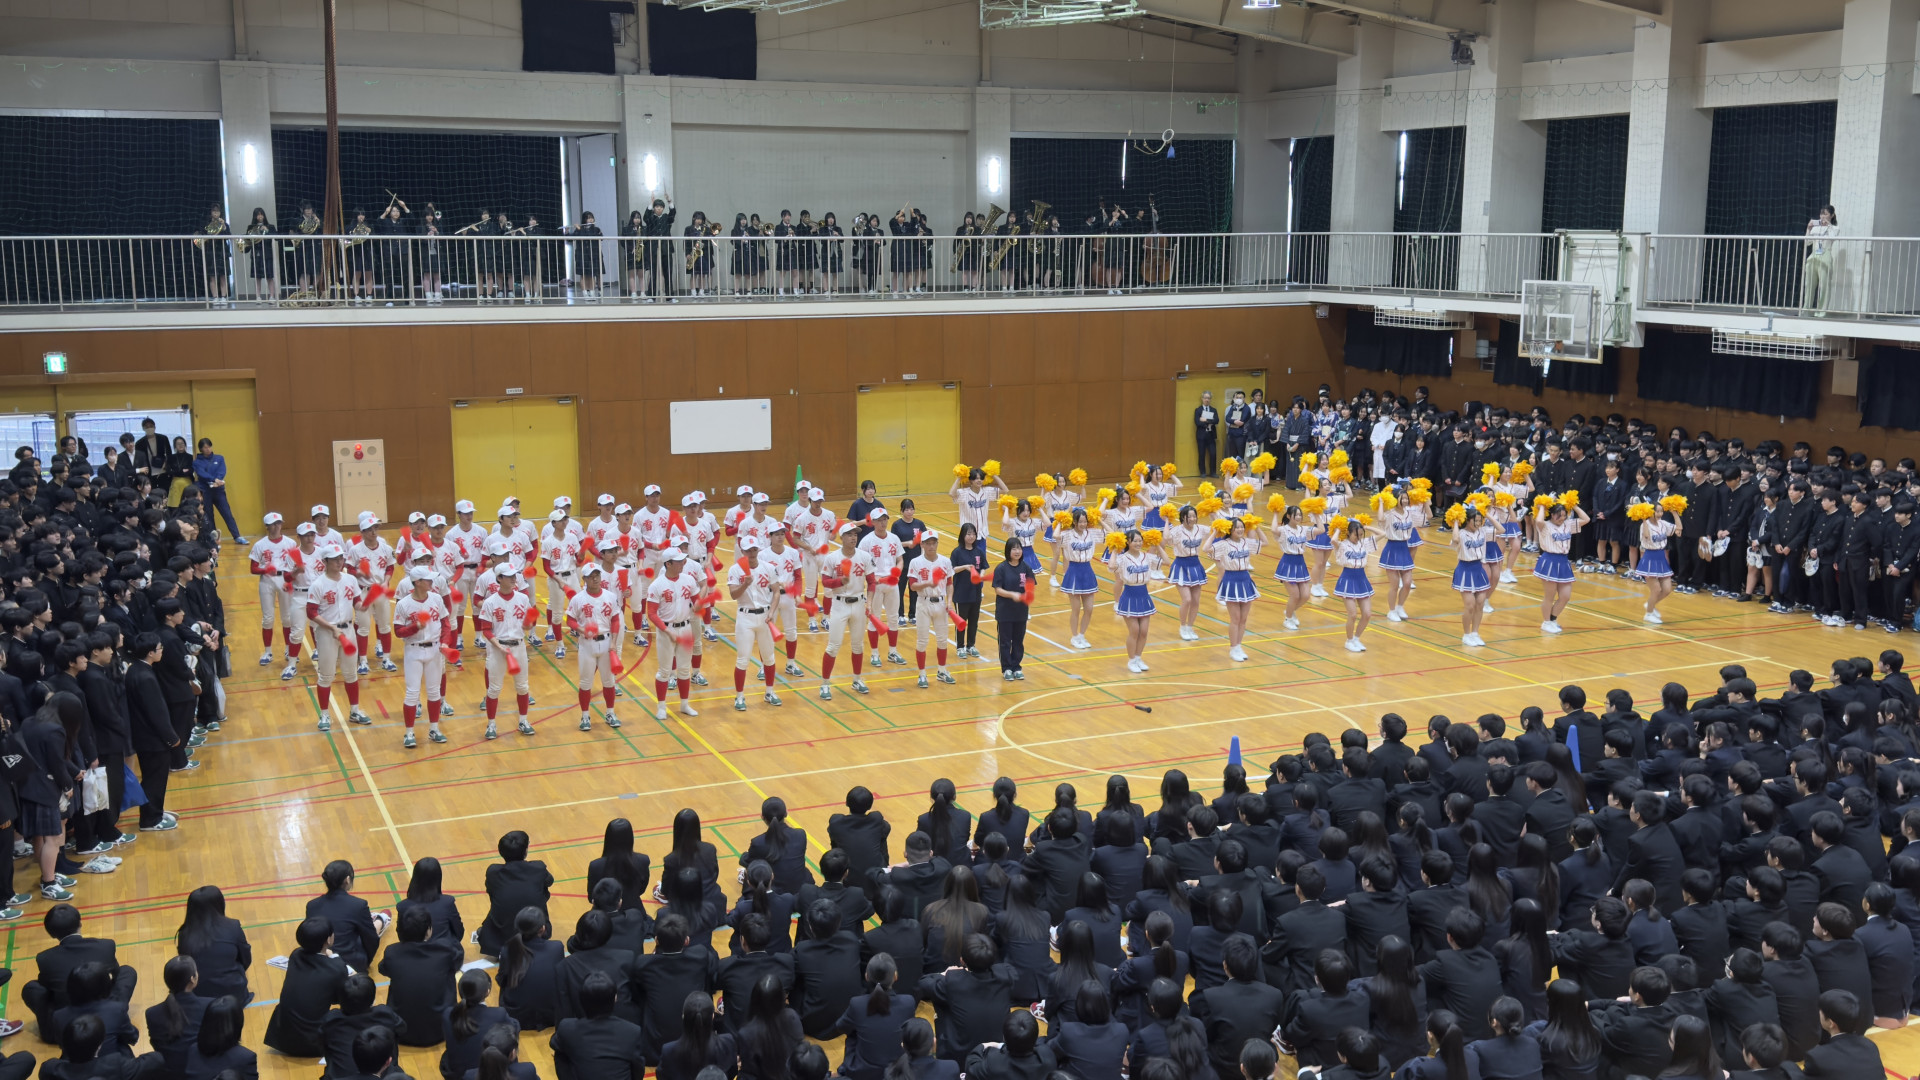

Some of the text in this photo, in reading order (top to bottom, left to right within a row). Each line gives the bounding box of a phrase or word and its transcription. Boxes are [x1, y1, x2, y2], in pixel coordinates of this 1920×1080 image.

[643, 516, 668, 532] 雪谷
[805, 519, 831, 535] 雪谷
[551, 543, 576, 561] 雪谷
[870, 543, 898, 558] 雪谷
[359, 556, 388, 569] 谷
[768, 559, 794, 573] 谷
[918, 567, 947, 582] 雪
[323, 585, 355, 605] 雪谷
[661, 585, 692, 603] 雪谷
[492, 604, 525, 623] 雪谷
[581, 602, 613, 618] 雪谷
